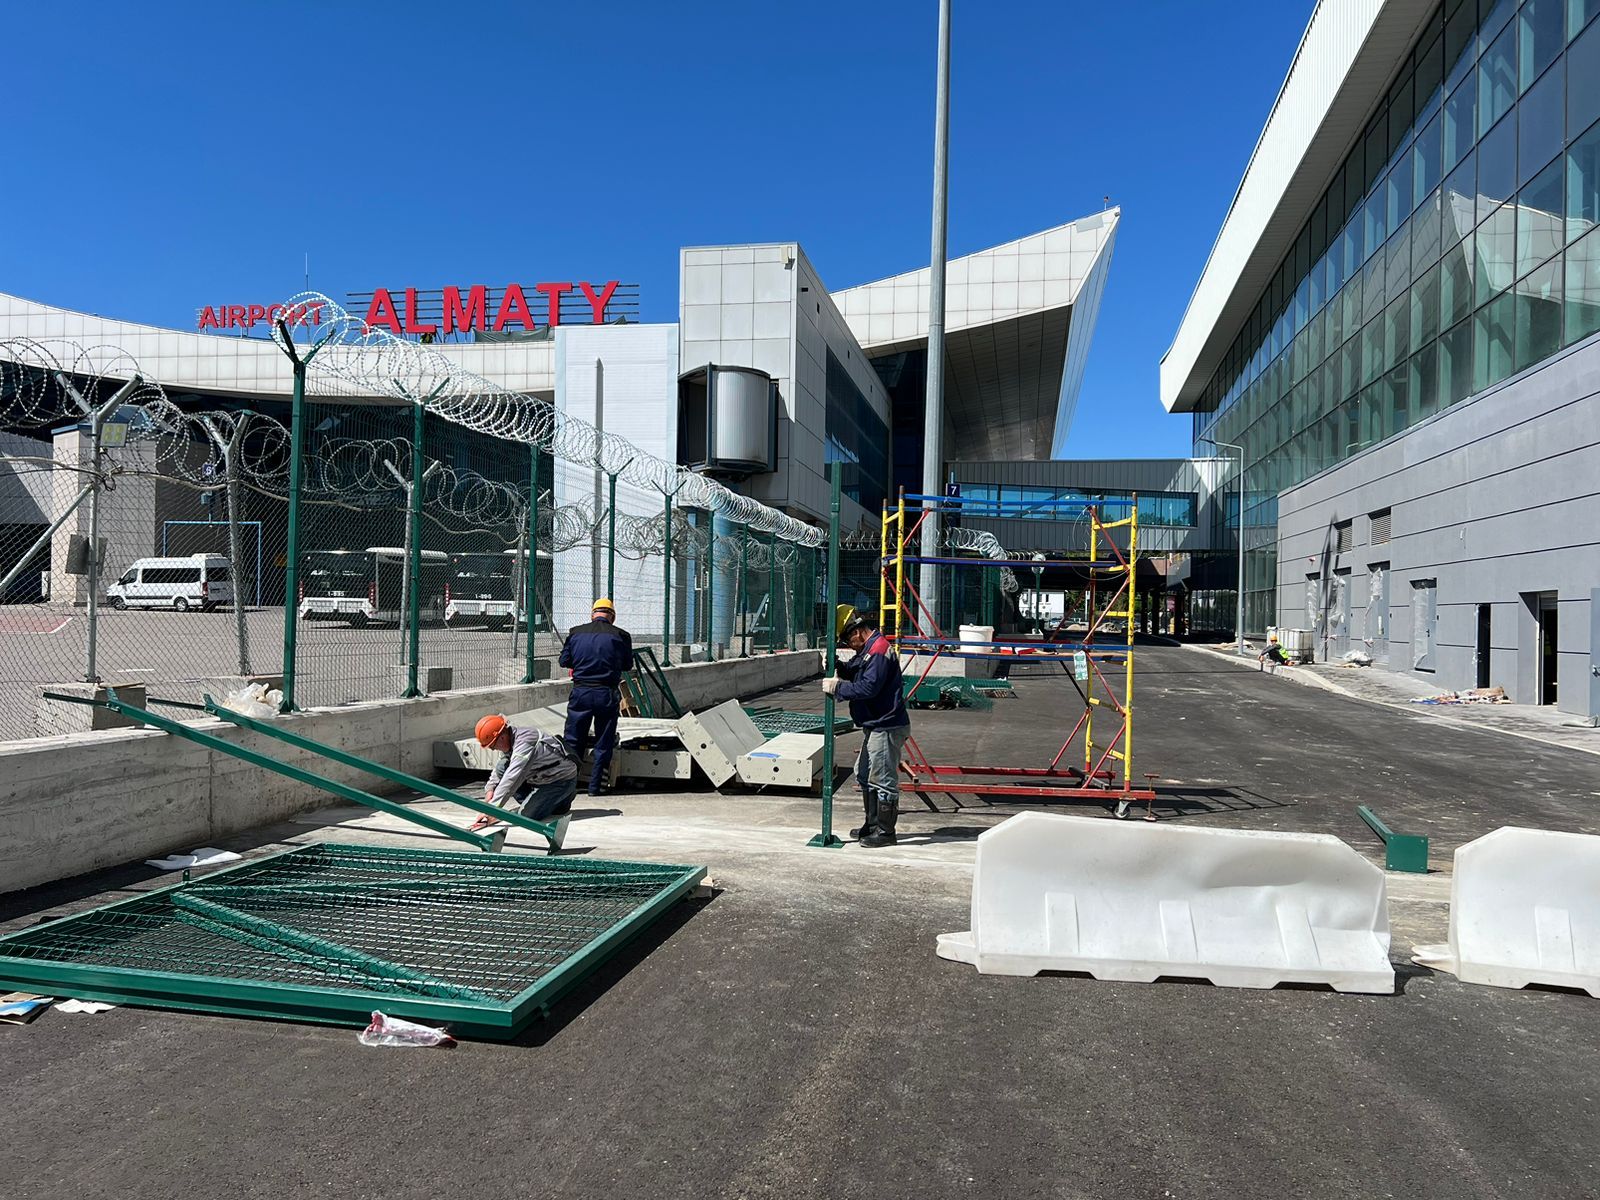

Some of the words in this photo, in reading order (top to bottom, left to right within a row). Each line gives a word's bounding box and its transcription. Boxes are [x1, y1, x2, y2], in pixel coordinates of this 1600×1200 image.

[199, 303, 325, 329] AIRPORT
[361, 281, 619, 334] ALMATY
[951, 486, 957, 495] 7
